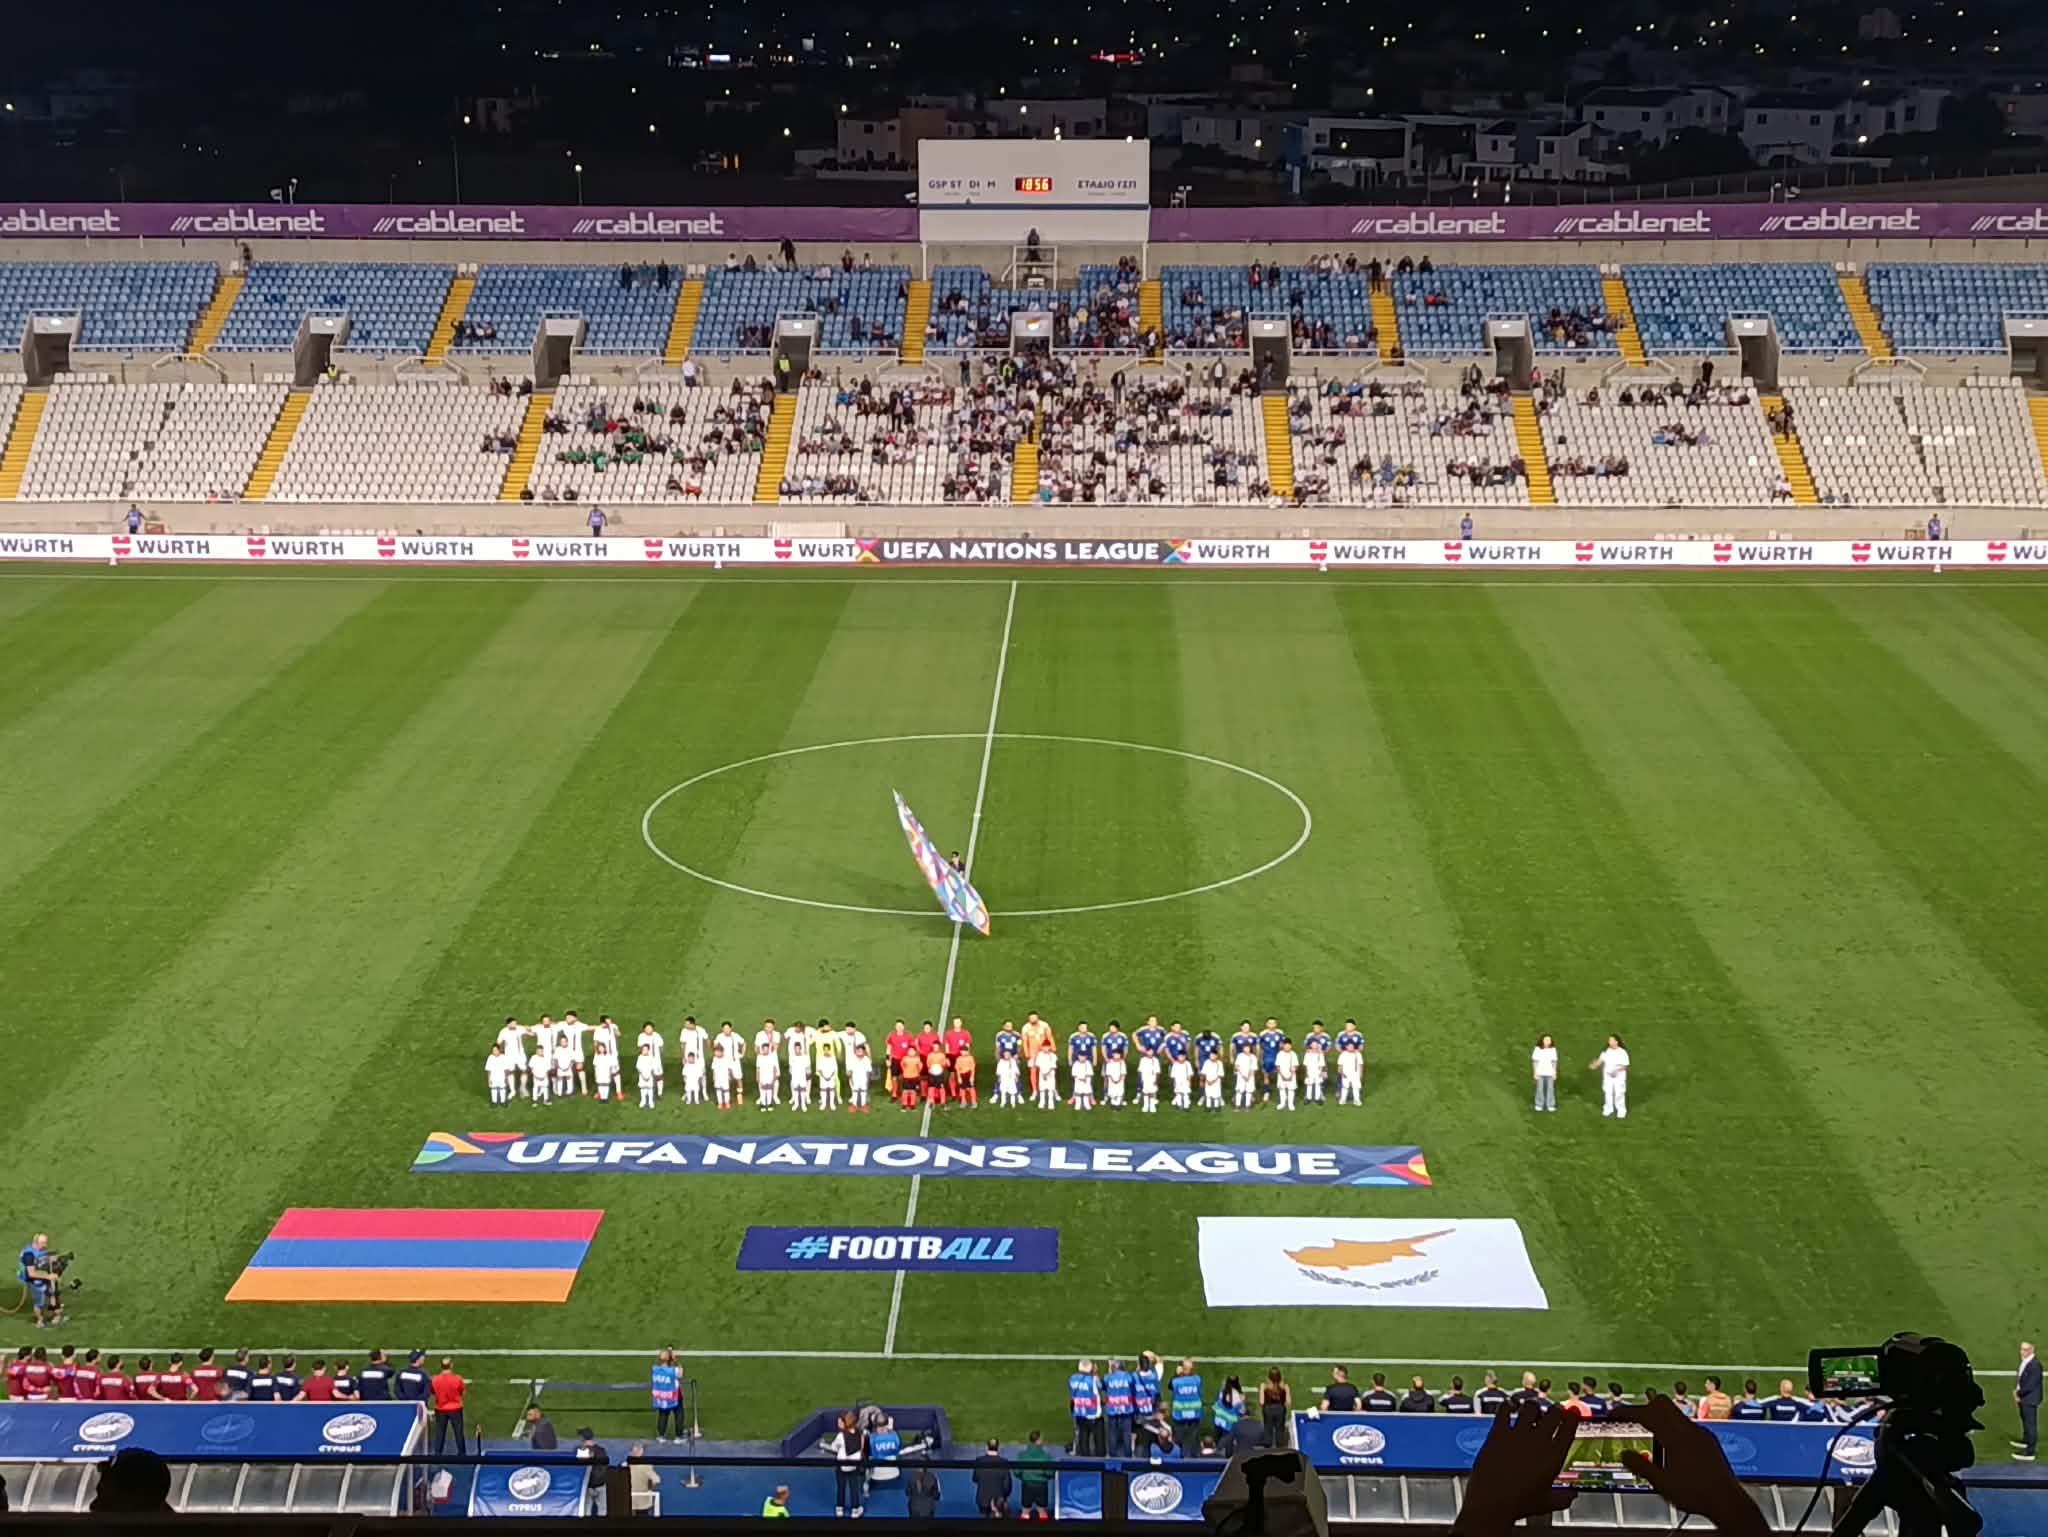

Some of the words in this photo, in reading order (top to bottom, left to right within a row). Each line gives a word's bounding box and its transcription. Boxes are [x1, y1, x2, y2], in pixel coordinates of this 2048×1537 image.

[0, 208, 121, 231] ablenet
[194, 209, 325, 232] cablenet
[397, 210, 525, 233] cablenet
[597, 211, 724, 234] cablenet
[1376, 211, 1506, 235] cablenet
[1579, 209, 1711, 233] cablenet
[1785, 208, 1921, 231] cablenet
[137, 540, 210, 555] WÜRTH
[271, 541, 345, 556] WÜRTH
[402, 542, 474, 556] WÜRTH
[536, 543, 608, 557] WÜRTH
[668, 543, 741, 558] WÜRTH
[883, 541, 944, 559] UEFA
[949, 542, 1057, 560] NATIONS
[1064, 542, 1159, 561] LEAGUE
[1198, 544, 1270, 559] WÜRTH
[1333, 544, 1406, 560] WÜRTH
[1469, 546, 1541, 560] WÜRTH
[1600, 545, 1673, 560] WÜRTH
[1738, 545, 1813, 561] WÜRTH
[1876, 545, 1953, 560] WÜRTH
[506, 1141, 688, 1165] UEFA
[702, 1143, 1031, 1169] NATIONS
[1049, 1146, 1341, 1175] LEAGUE
[785, 1236, 1014, 1260] #FOOTBALL
